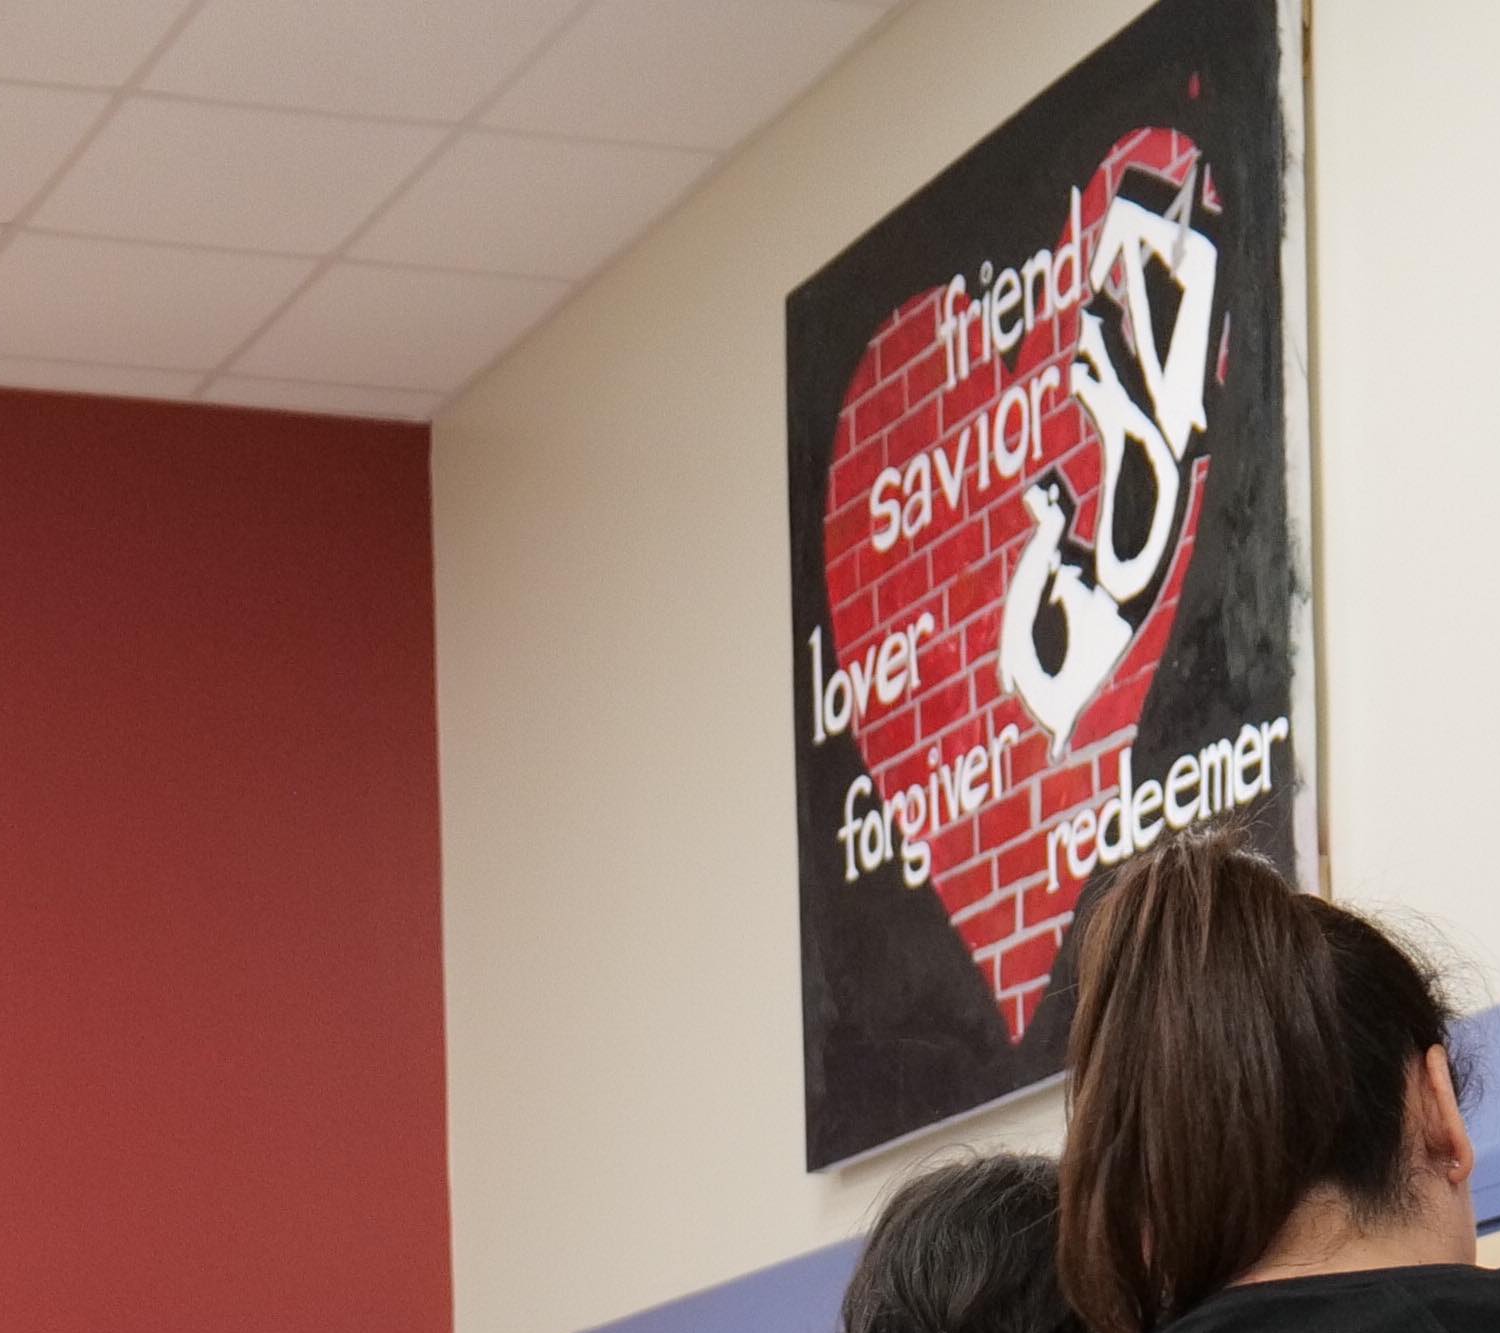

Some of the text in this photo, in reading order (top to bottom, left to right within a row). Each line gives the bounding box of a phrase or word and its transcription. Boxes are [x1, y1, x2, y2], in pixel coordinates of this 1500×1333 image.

[937, 186, 1084, 388] friend
[869, 362, 1061, 554] savior
[808, 612, 935, 747] lover
[837, 722, 1019, 888] forgiver
[1045, 715, 1288, 893] redeemer
